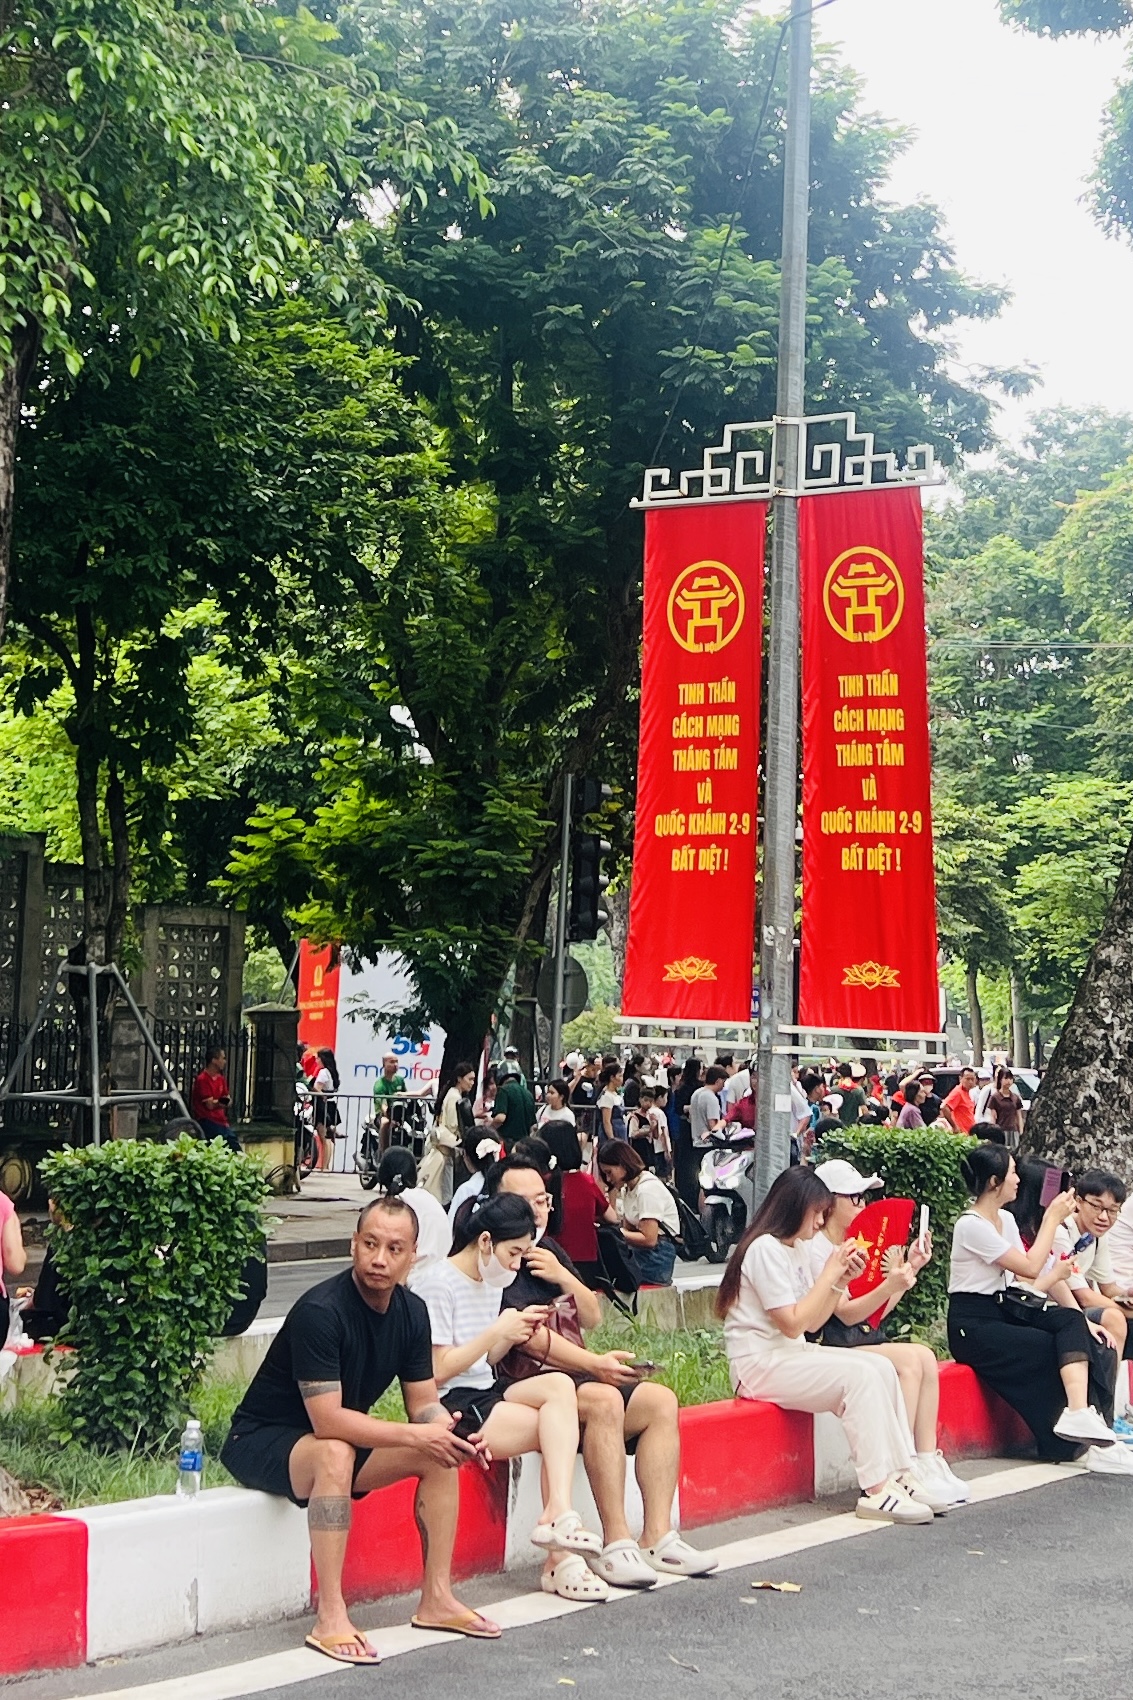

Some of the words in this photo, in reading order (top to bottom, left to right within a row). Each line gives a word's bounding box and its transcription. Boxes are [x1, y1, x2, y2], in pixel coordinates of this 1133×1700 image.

[678, 682, 704, 705] TINH
[838, 675, 864, 698] TINH
[672, 711, 703, 738] CÁCH
[706, 714, 740, 741] MẠNG
[833, 704, 864, 732] CÁCH
[867, 708, 904, 736] MẠNG
[673, 744, 710, 771] THÁNG
[713, 742, 738, 770] TÁM
[836, 739, 873, 767] THÁNG
[876, 738, 904, 766] TÁM
[697, 777, 712, 804] VÀ
[862, 772, 877, 801] VÀ
[655, 808, 685, 837] QUỐC
[688, 808, 726, 835] KHÁNH
[729, 812, 750, 835] 2-9
[821, 805, 852, 835] QUỐC
[855, 805, 895, 833] KHÁNH
[899, 811, 922, 834] 2-9
[671, 843, 696, 871] BẤT
[698, 843, 722, 875] DIỆT
[841, 842, 864, 871] BẤT
[867, 842, 892, 876] DIỆT
